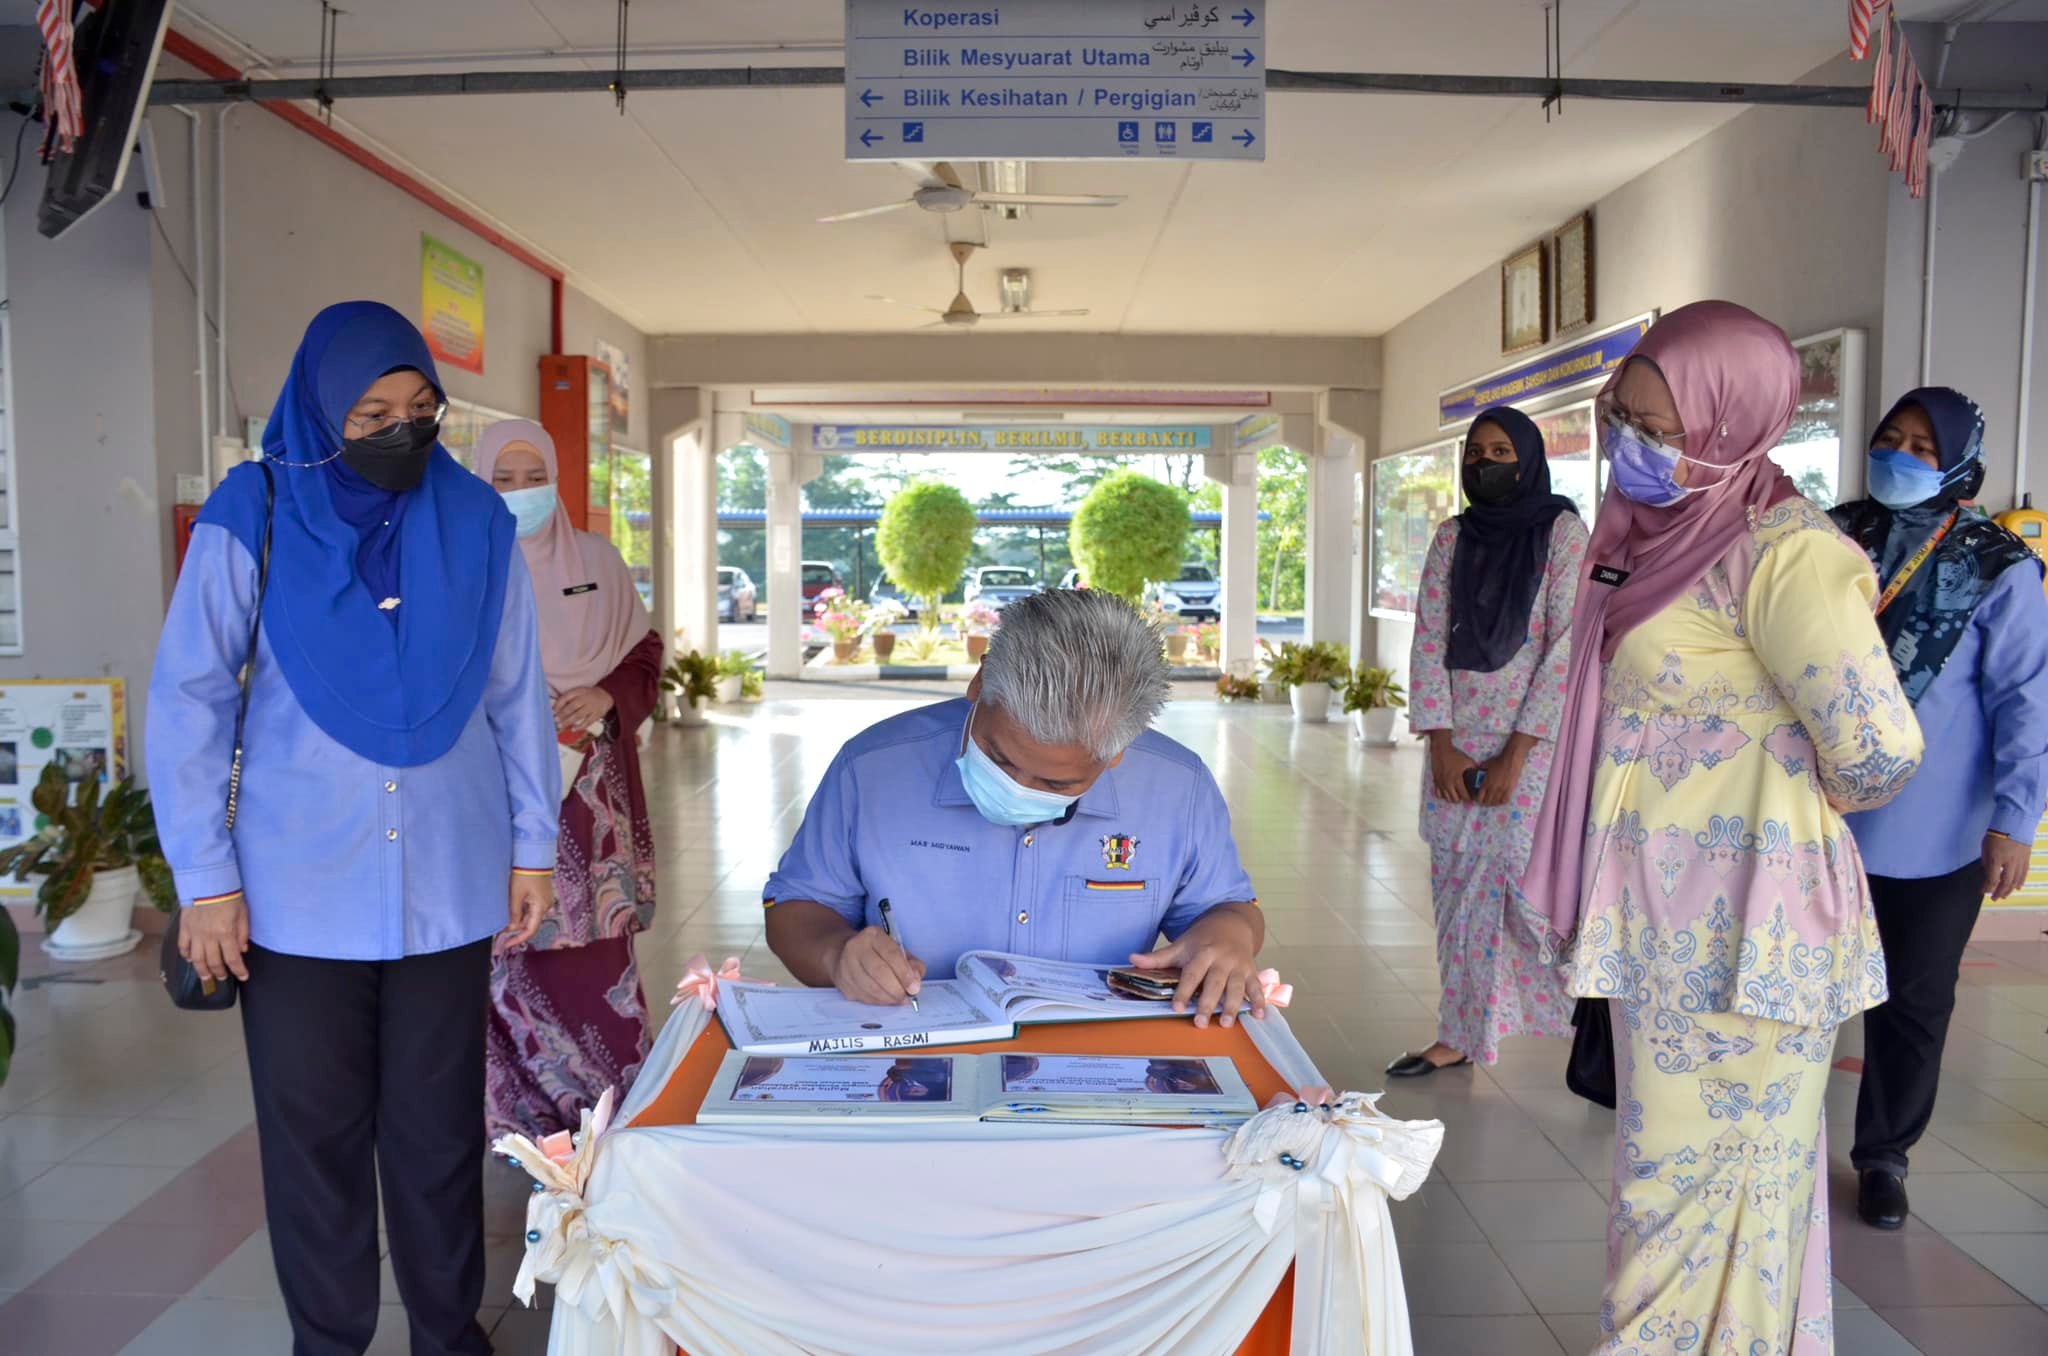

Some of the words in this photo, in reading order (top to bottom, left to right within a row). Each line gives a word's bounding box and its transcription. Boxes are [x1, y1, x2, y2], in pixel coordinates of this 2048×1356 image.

[903, 8, 999, 29] Koperasi
[903, 48, 950, 66] Bilik
[961, 48, 1072, 69] Mesyuarat
[1082, 48, 1150, 66] Utama
[903, 88, 950, 106] Bilik
[961, 88, 1068, 106] Kesihatan
[1078, 88, 1085, 106] /
[1094, 88, 1196, 110] Pergigian
[855, 430, 988, 449] BERDISIPLIN,
[995, 431, 1088, 449] BERILMU,
[1096, 431, 1196, 447] BERBAKTI
[808, 1037, 864, 1053] MAJLIS
[883, 1032, 929, 1048] RASMI
